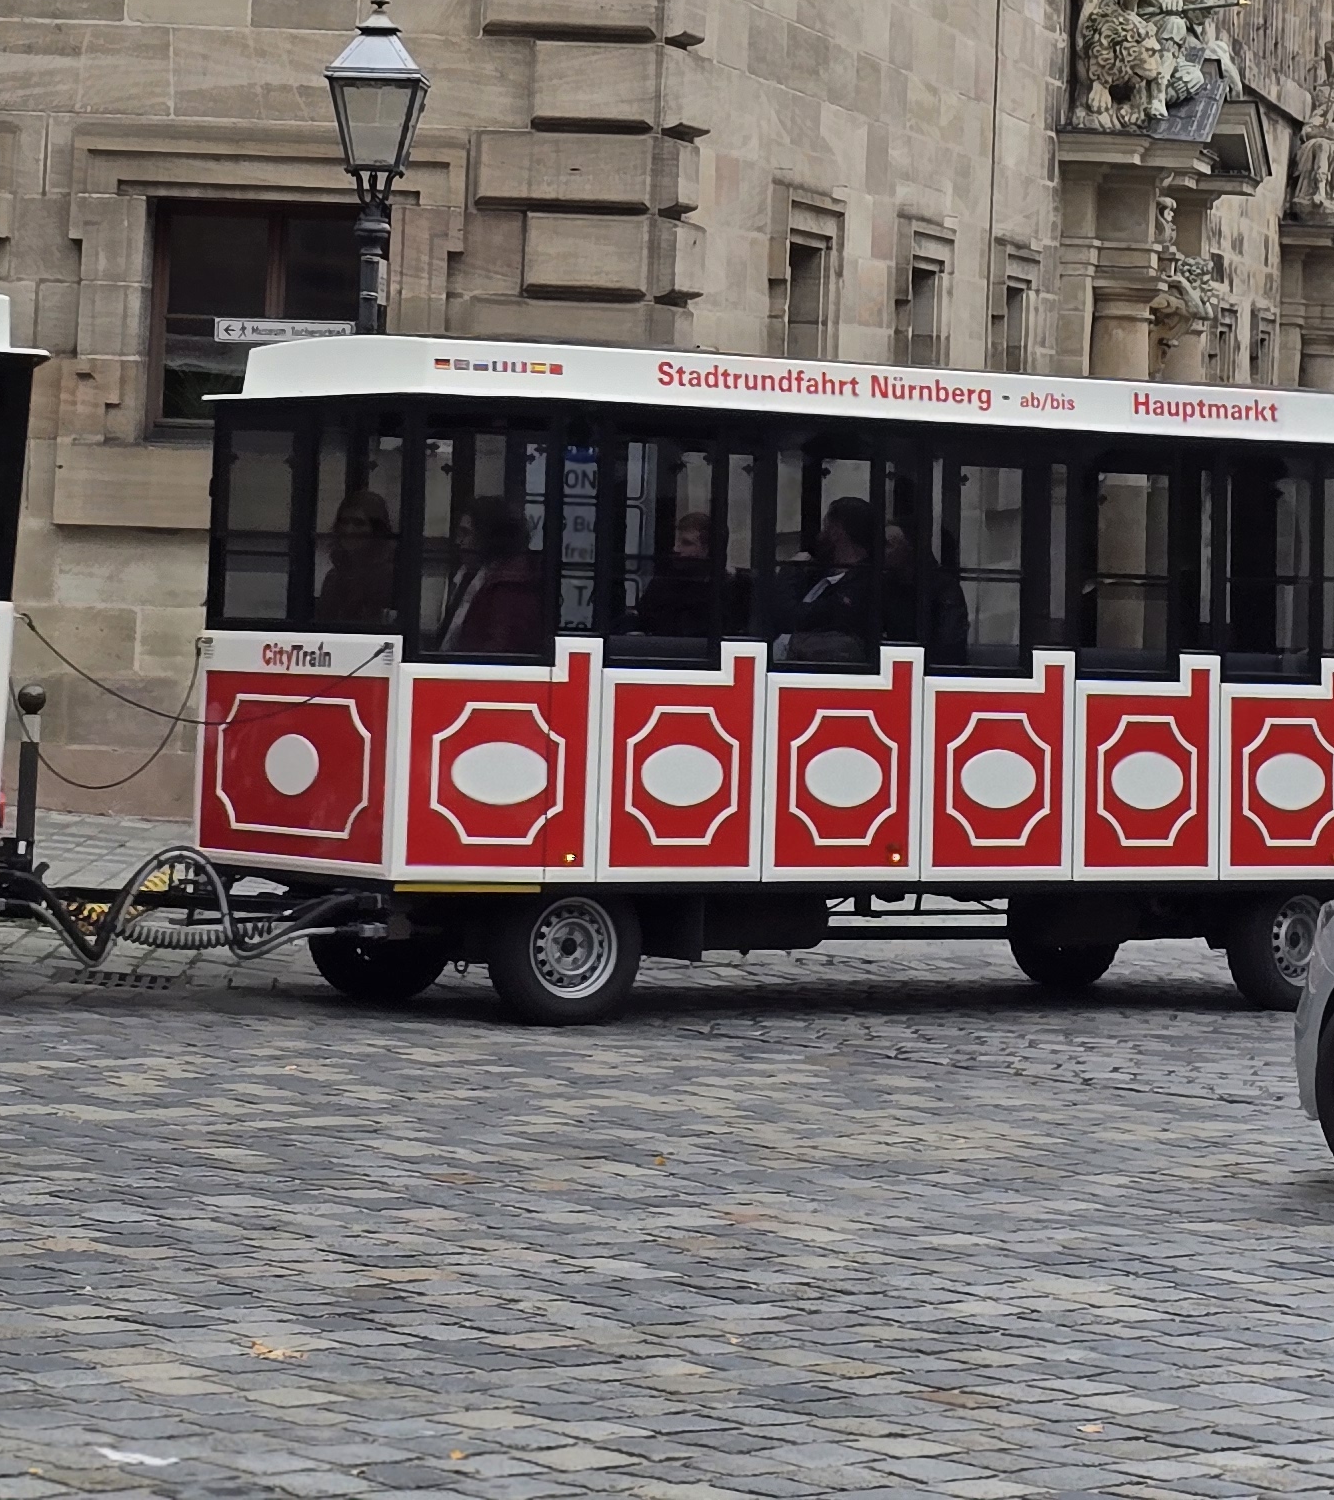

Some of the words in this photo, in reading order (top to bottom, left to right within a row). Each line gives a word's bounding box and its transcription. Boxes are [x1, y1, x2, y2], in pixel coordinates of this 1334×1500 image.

[657, 360, 859, 397] Stadtrundfahrt
[869, 374, 992, 411] Nürnberg
[1020, 392, 1075, 411] ab/bis
[1132, 392, 1278, 423] Hauptmarkt
[262, 642, 332, 670] CityTrain
